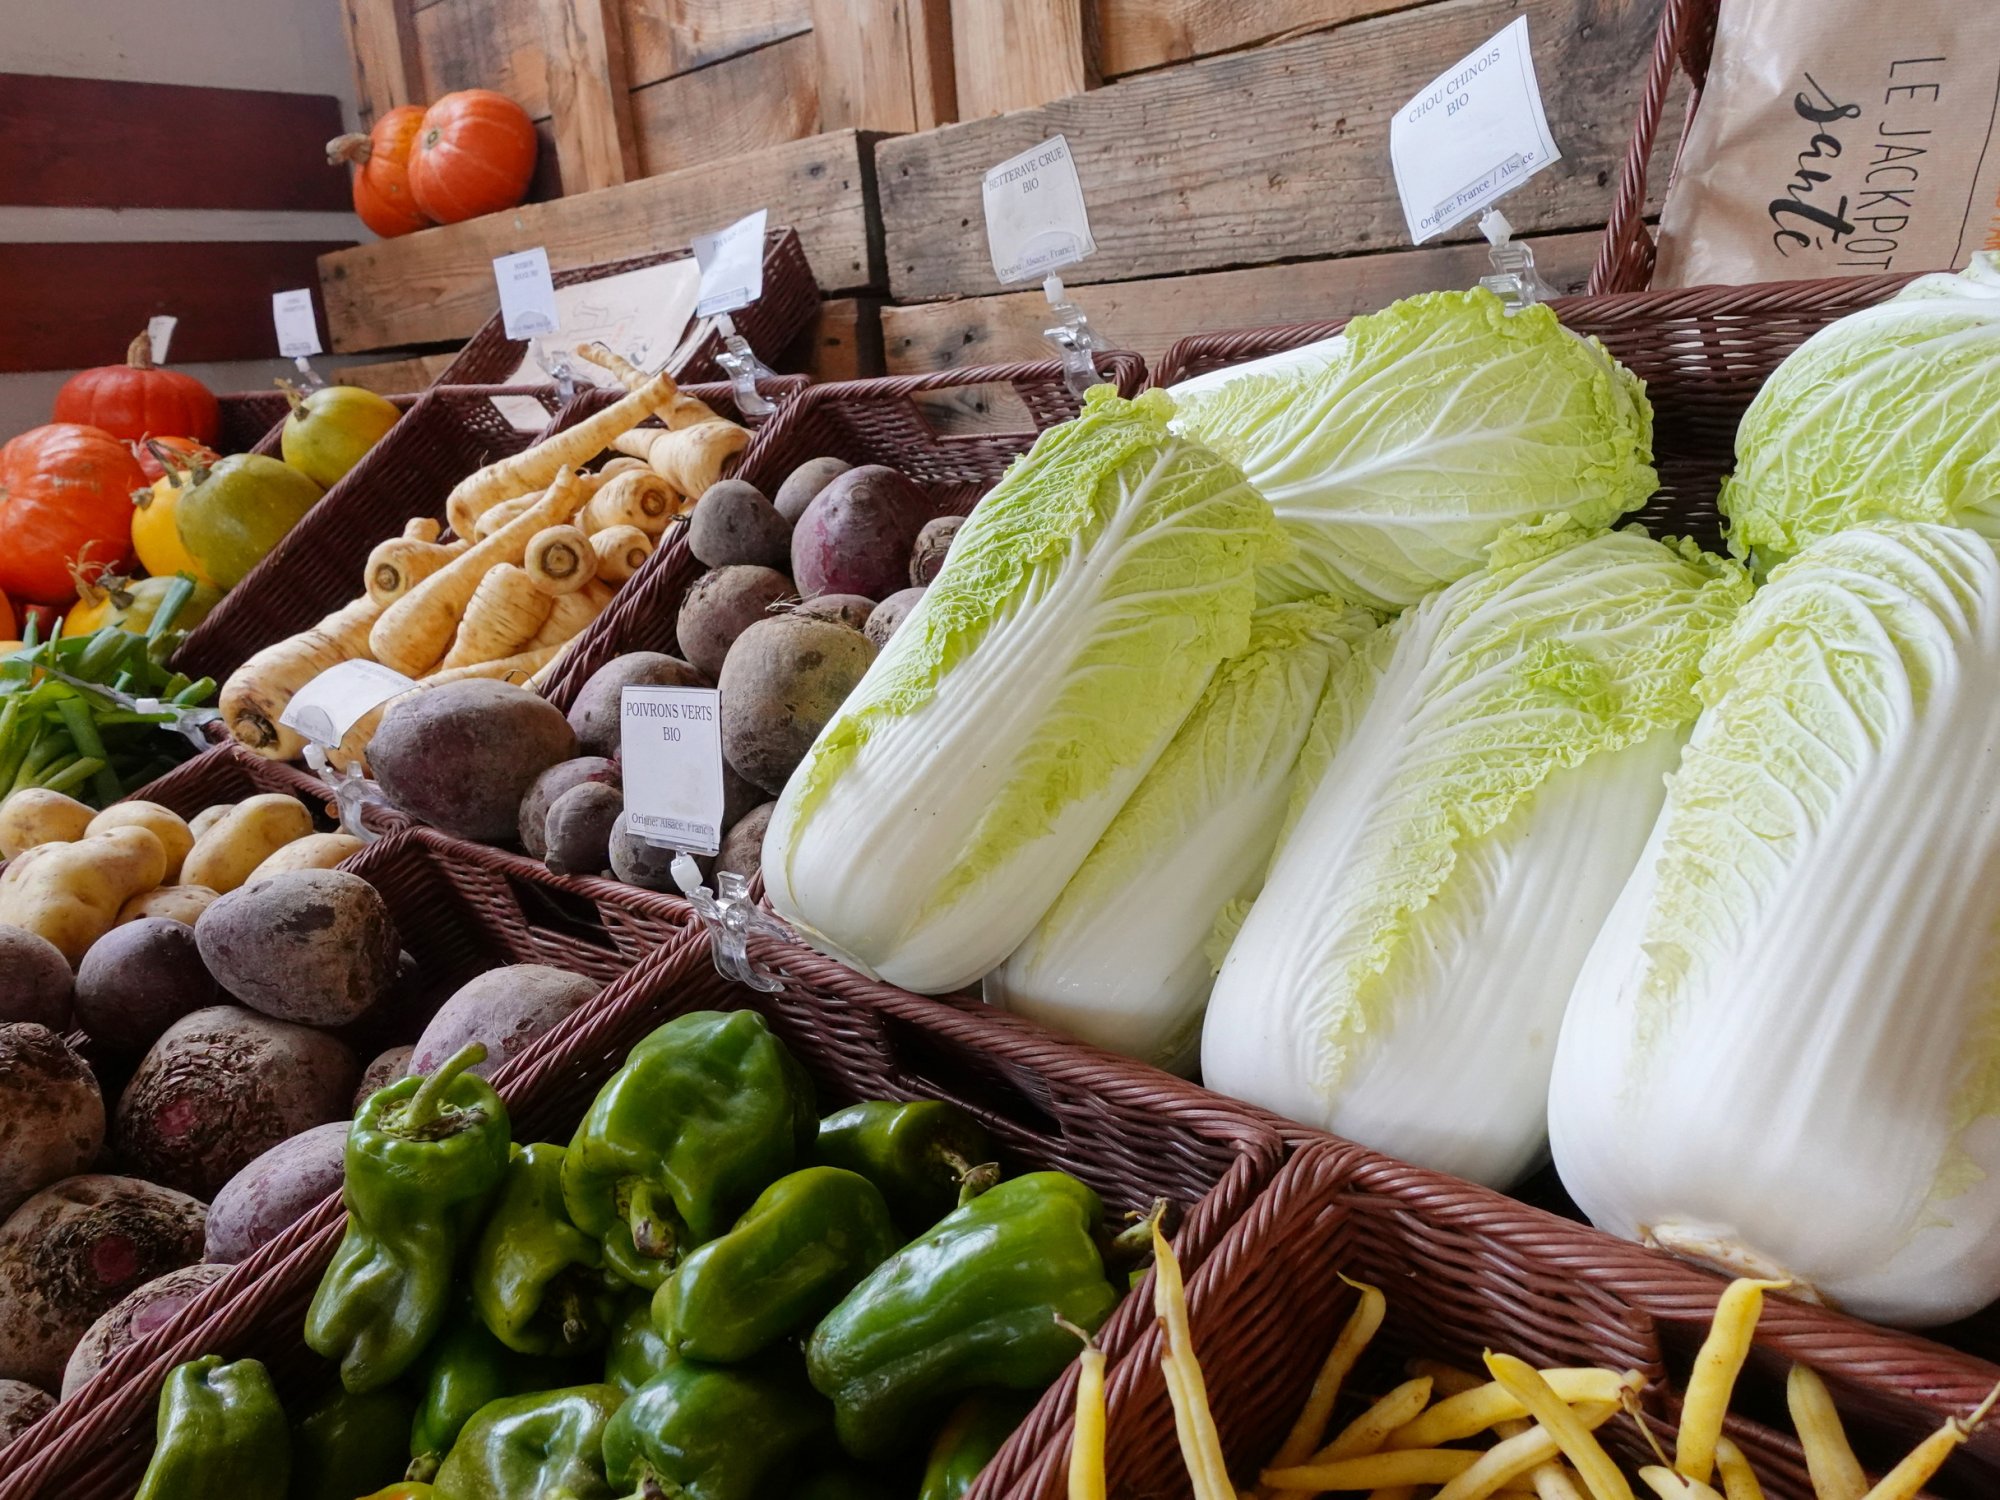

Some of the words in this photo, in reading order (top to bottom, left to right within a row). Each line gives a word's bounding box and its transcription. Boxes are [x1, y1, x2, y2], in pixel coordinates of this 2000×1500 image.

[1408, 89, 1444, 123] CHOU
[1446, 47, 1501, 95] CHINOIS
[1884, 57, 1947, 105] LE
[1446, 92, 1470, 117] BIO
[988, 159, 1038, 192] BETTERAVE
[1038, 147, 1064, 168] CRUE
[1022, 178, 1039, 194] BIO
[1420, 200, 1456, 230] Origine:
[1456, 179, 1491, 206] France
[1837, 122, 1932, 270] JACKPOT
[626, 702, 679, 719] POIVRONS
[681, 704, 713, 721] VERTS
[662, 726, 681, 742] BIO
[631, 812, 659, 828] Oriine:
